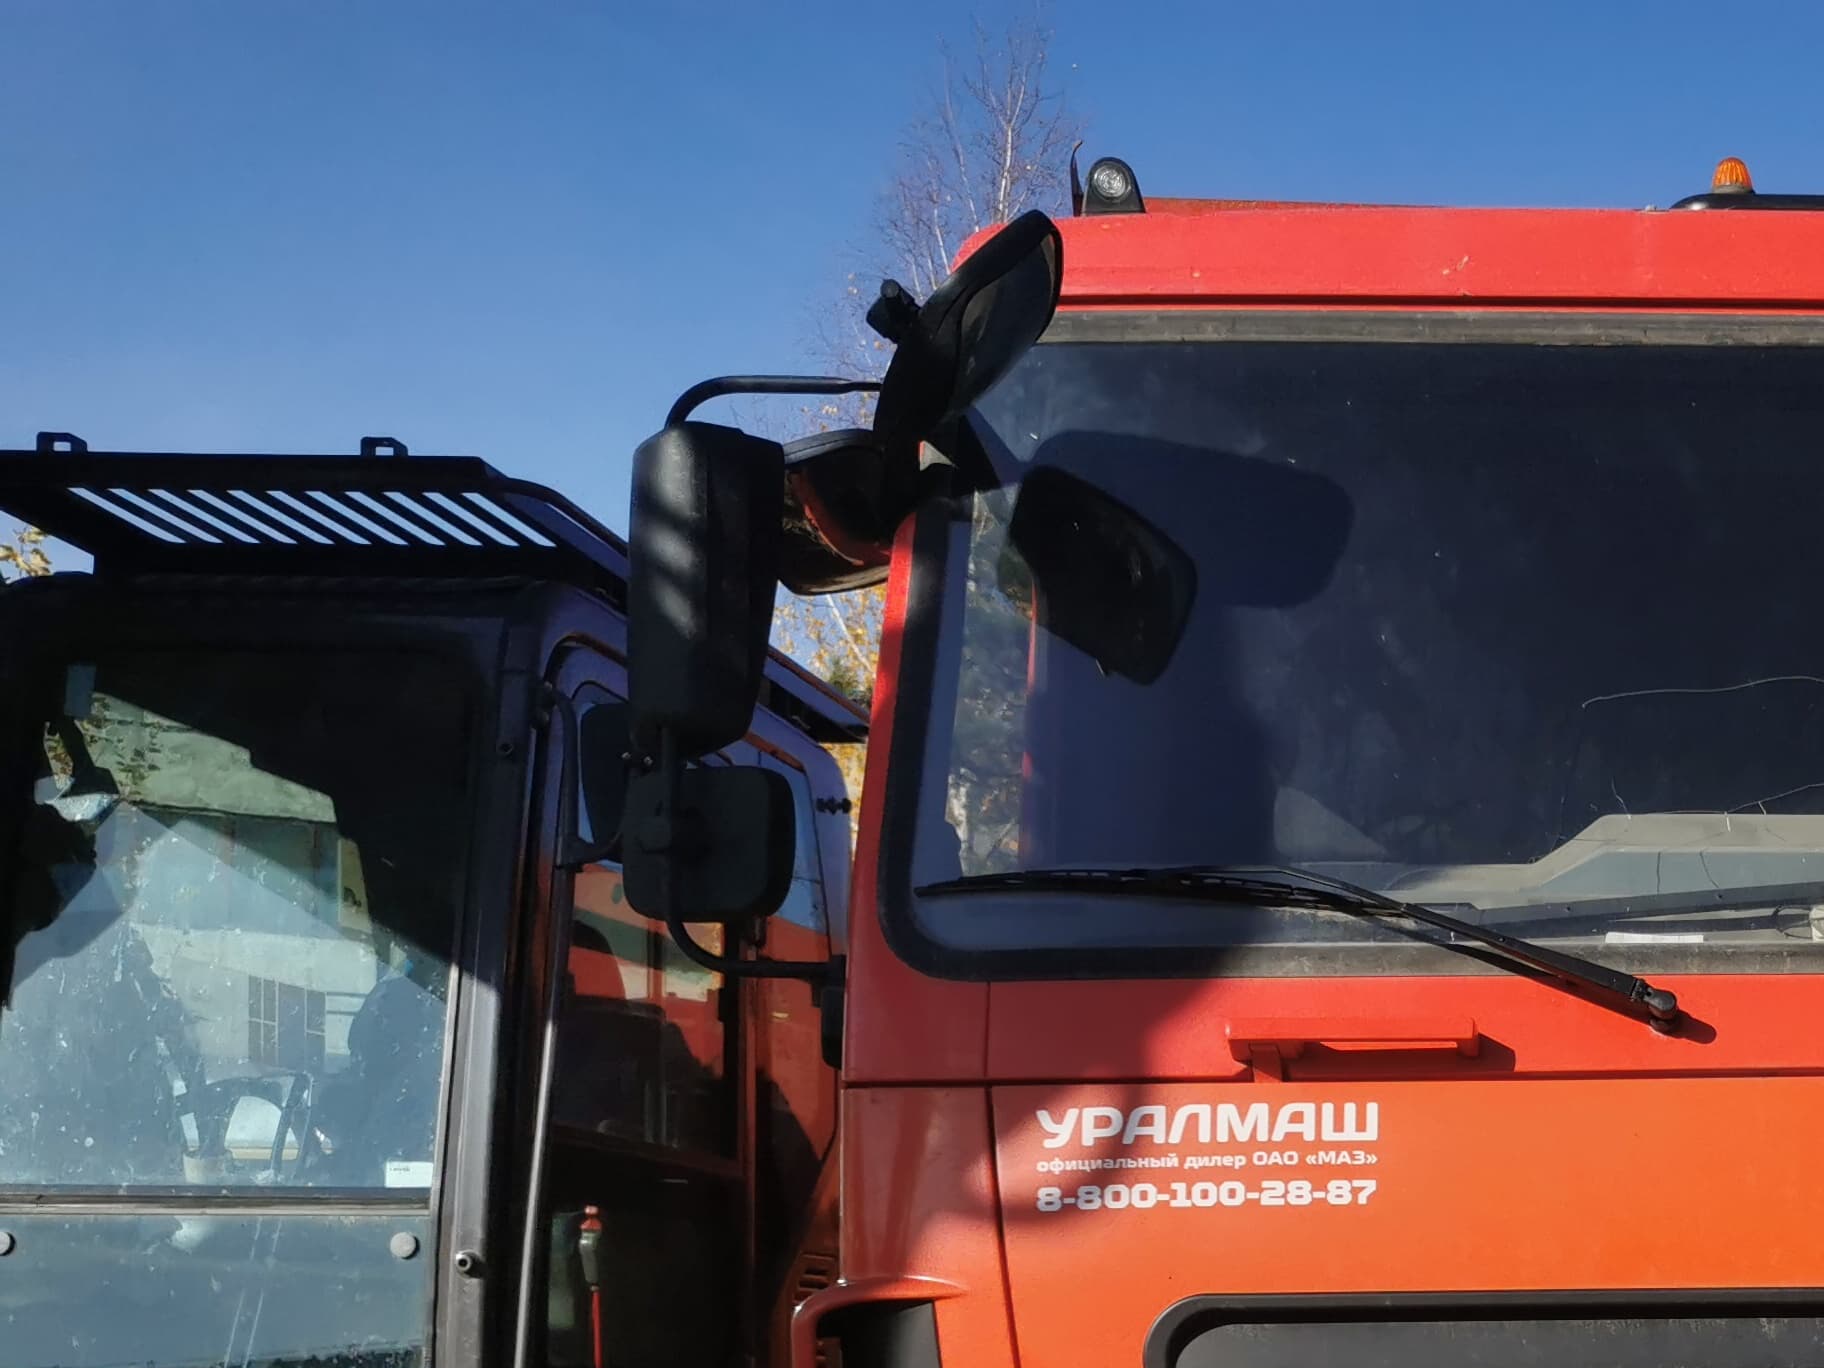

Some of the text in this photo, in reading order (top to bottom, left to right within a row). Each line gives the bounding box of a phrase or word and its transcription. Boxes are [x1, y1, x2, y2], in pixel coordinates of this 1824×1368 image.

[1035, 1101, 1379, 1149] УРАЛМАШ
[1036, 1150, 1378, 1174] официальный дилер ОАО «МАЗ»
[1035, 1178, 1378, 1213] 8-800-100-28-87
